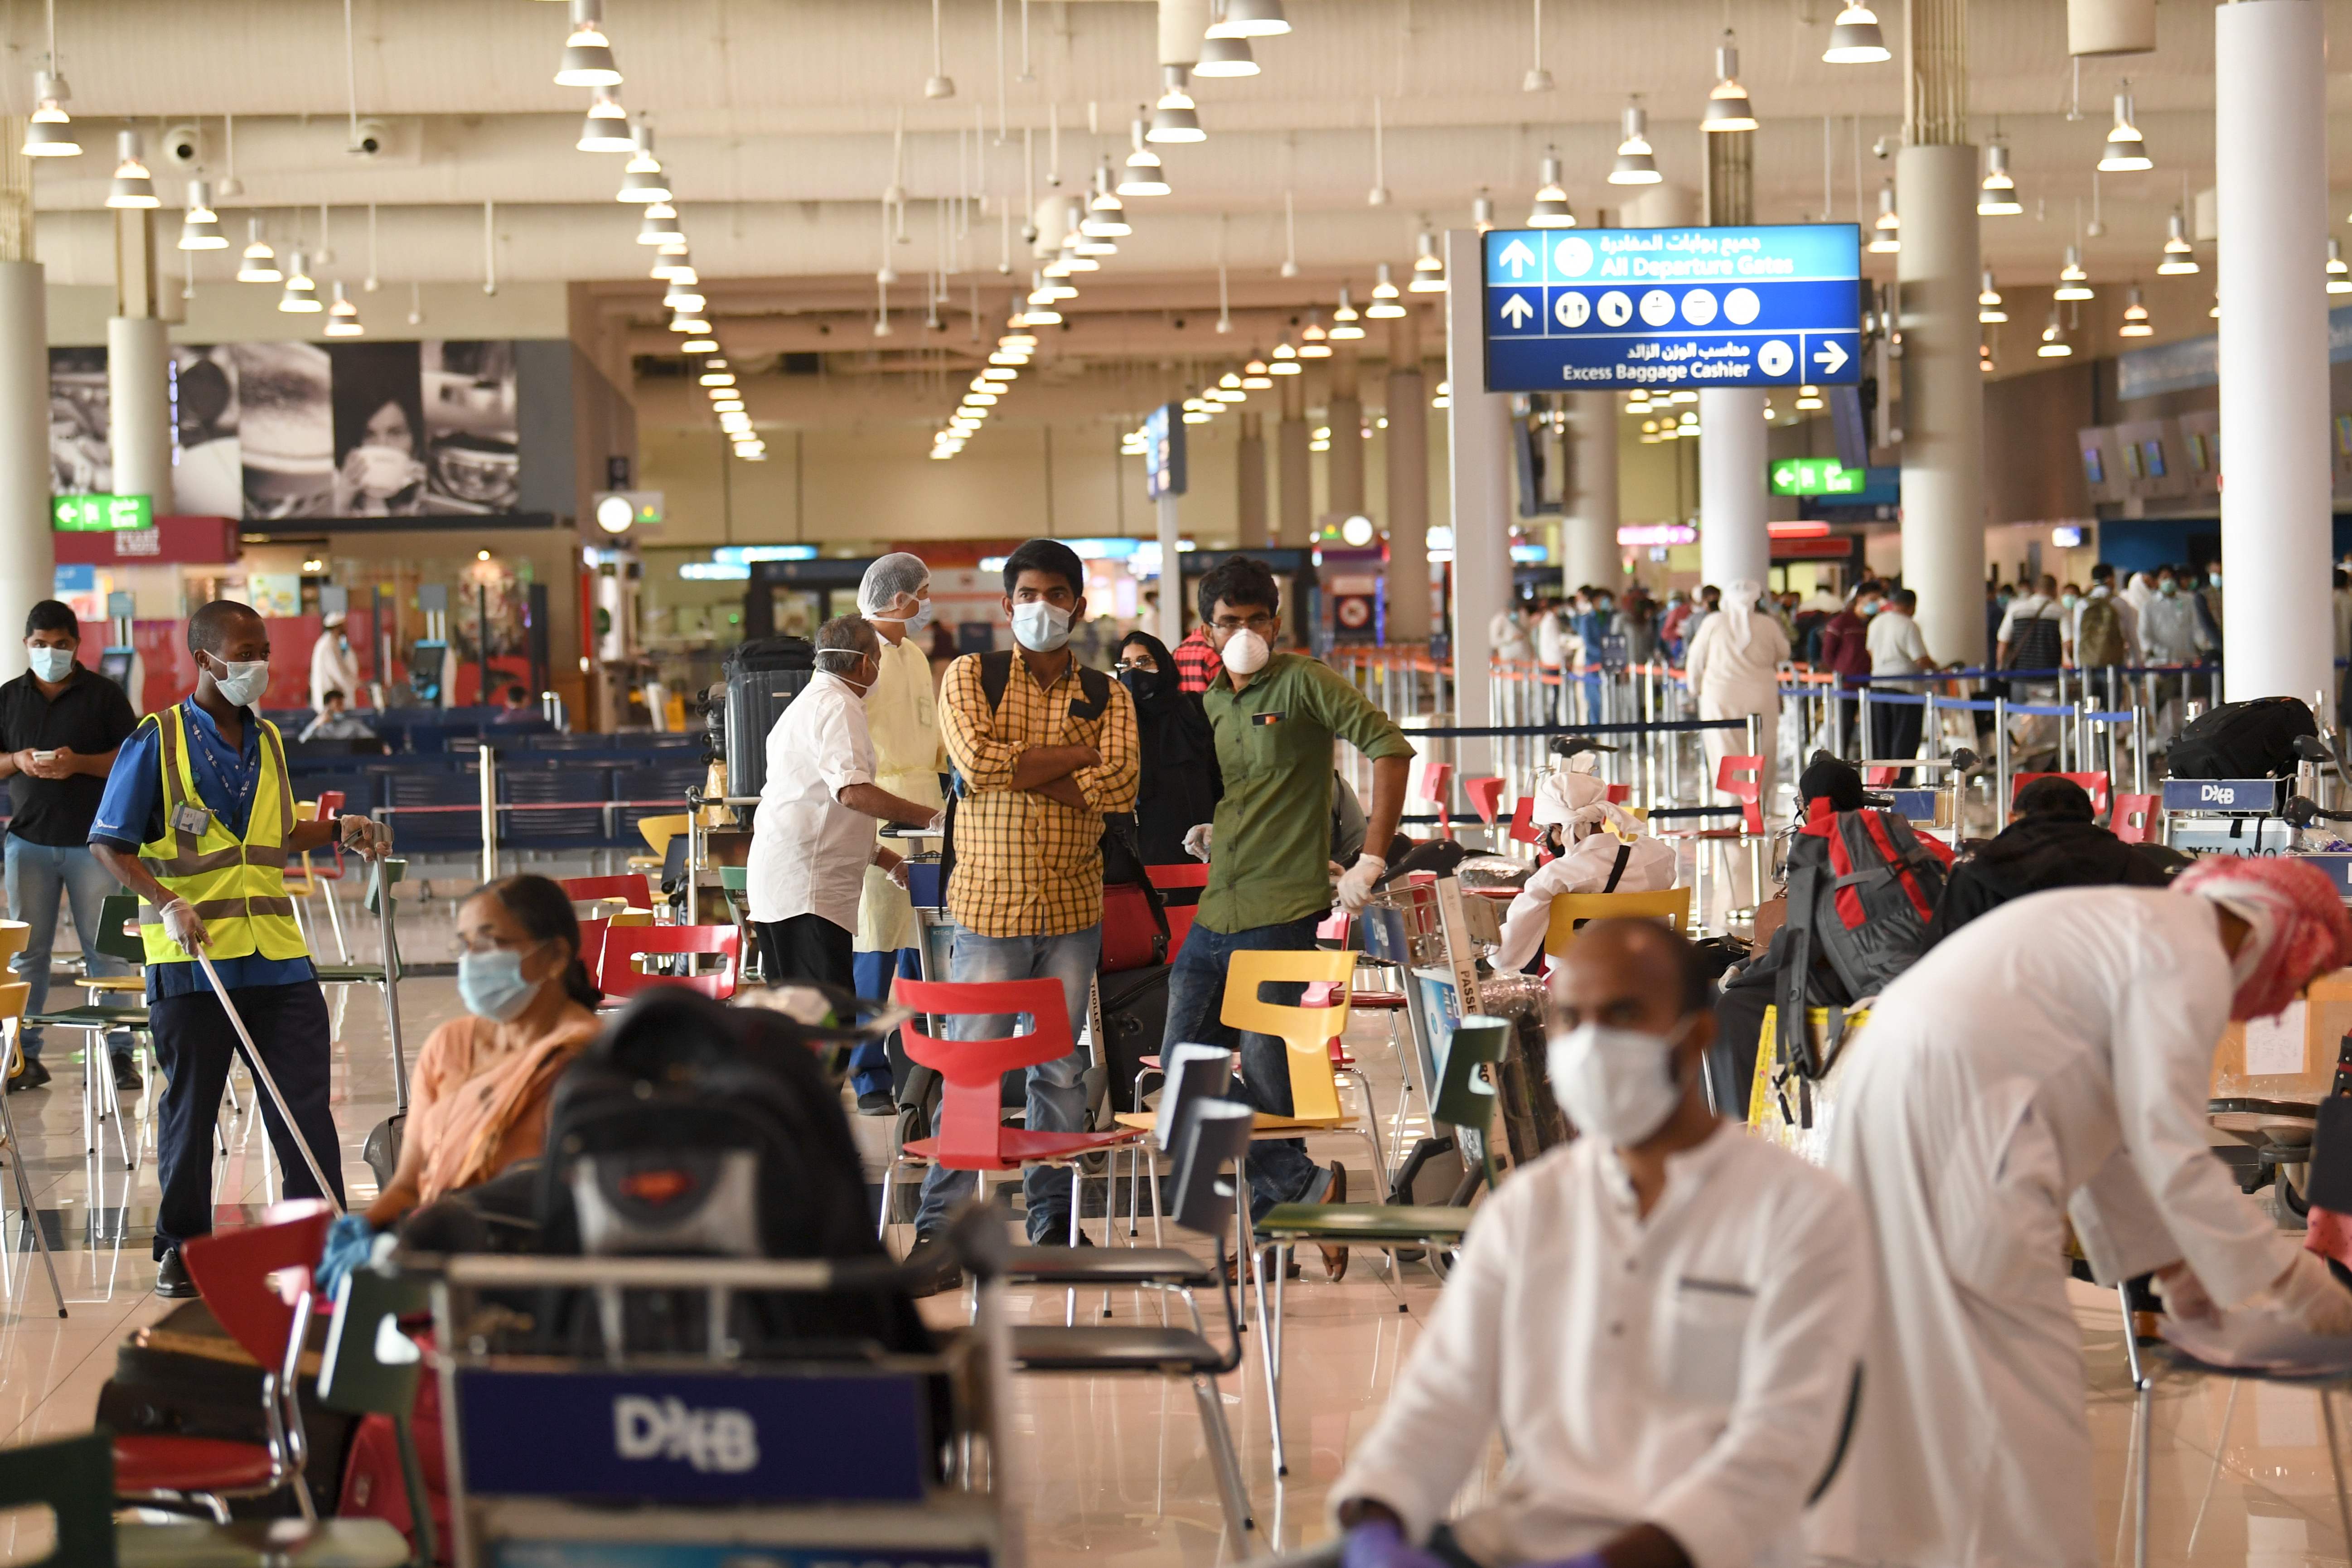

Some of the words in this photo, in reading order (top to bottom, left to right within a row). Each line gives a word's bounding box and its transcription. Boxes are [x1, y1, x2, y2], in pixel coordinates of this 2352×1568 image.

[1601, 257, 1628, 276] All
[1634, 257, 1733, 280] Departure
[1737, 255, 1794, 275] Gates
[1563, 364, 1612, 381] Excess
[1616, 363, 1687, 382] Baggage
[1690, 361, 1751, 378] Cashier
[1090, 982, 1100, 1033] TROLLEY
[1460, 970, 1477, 1014] PASSE
